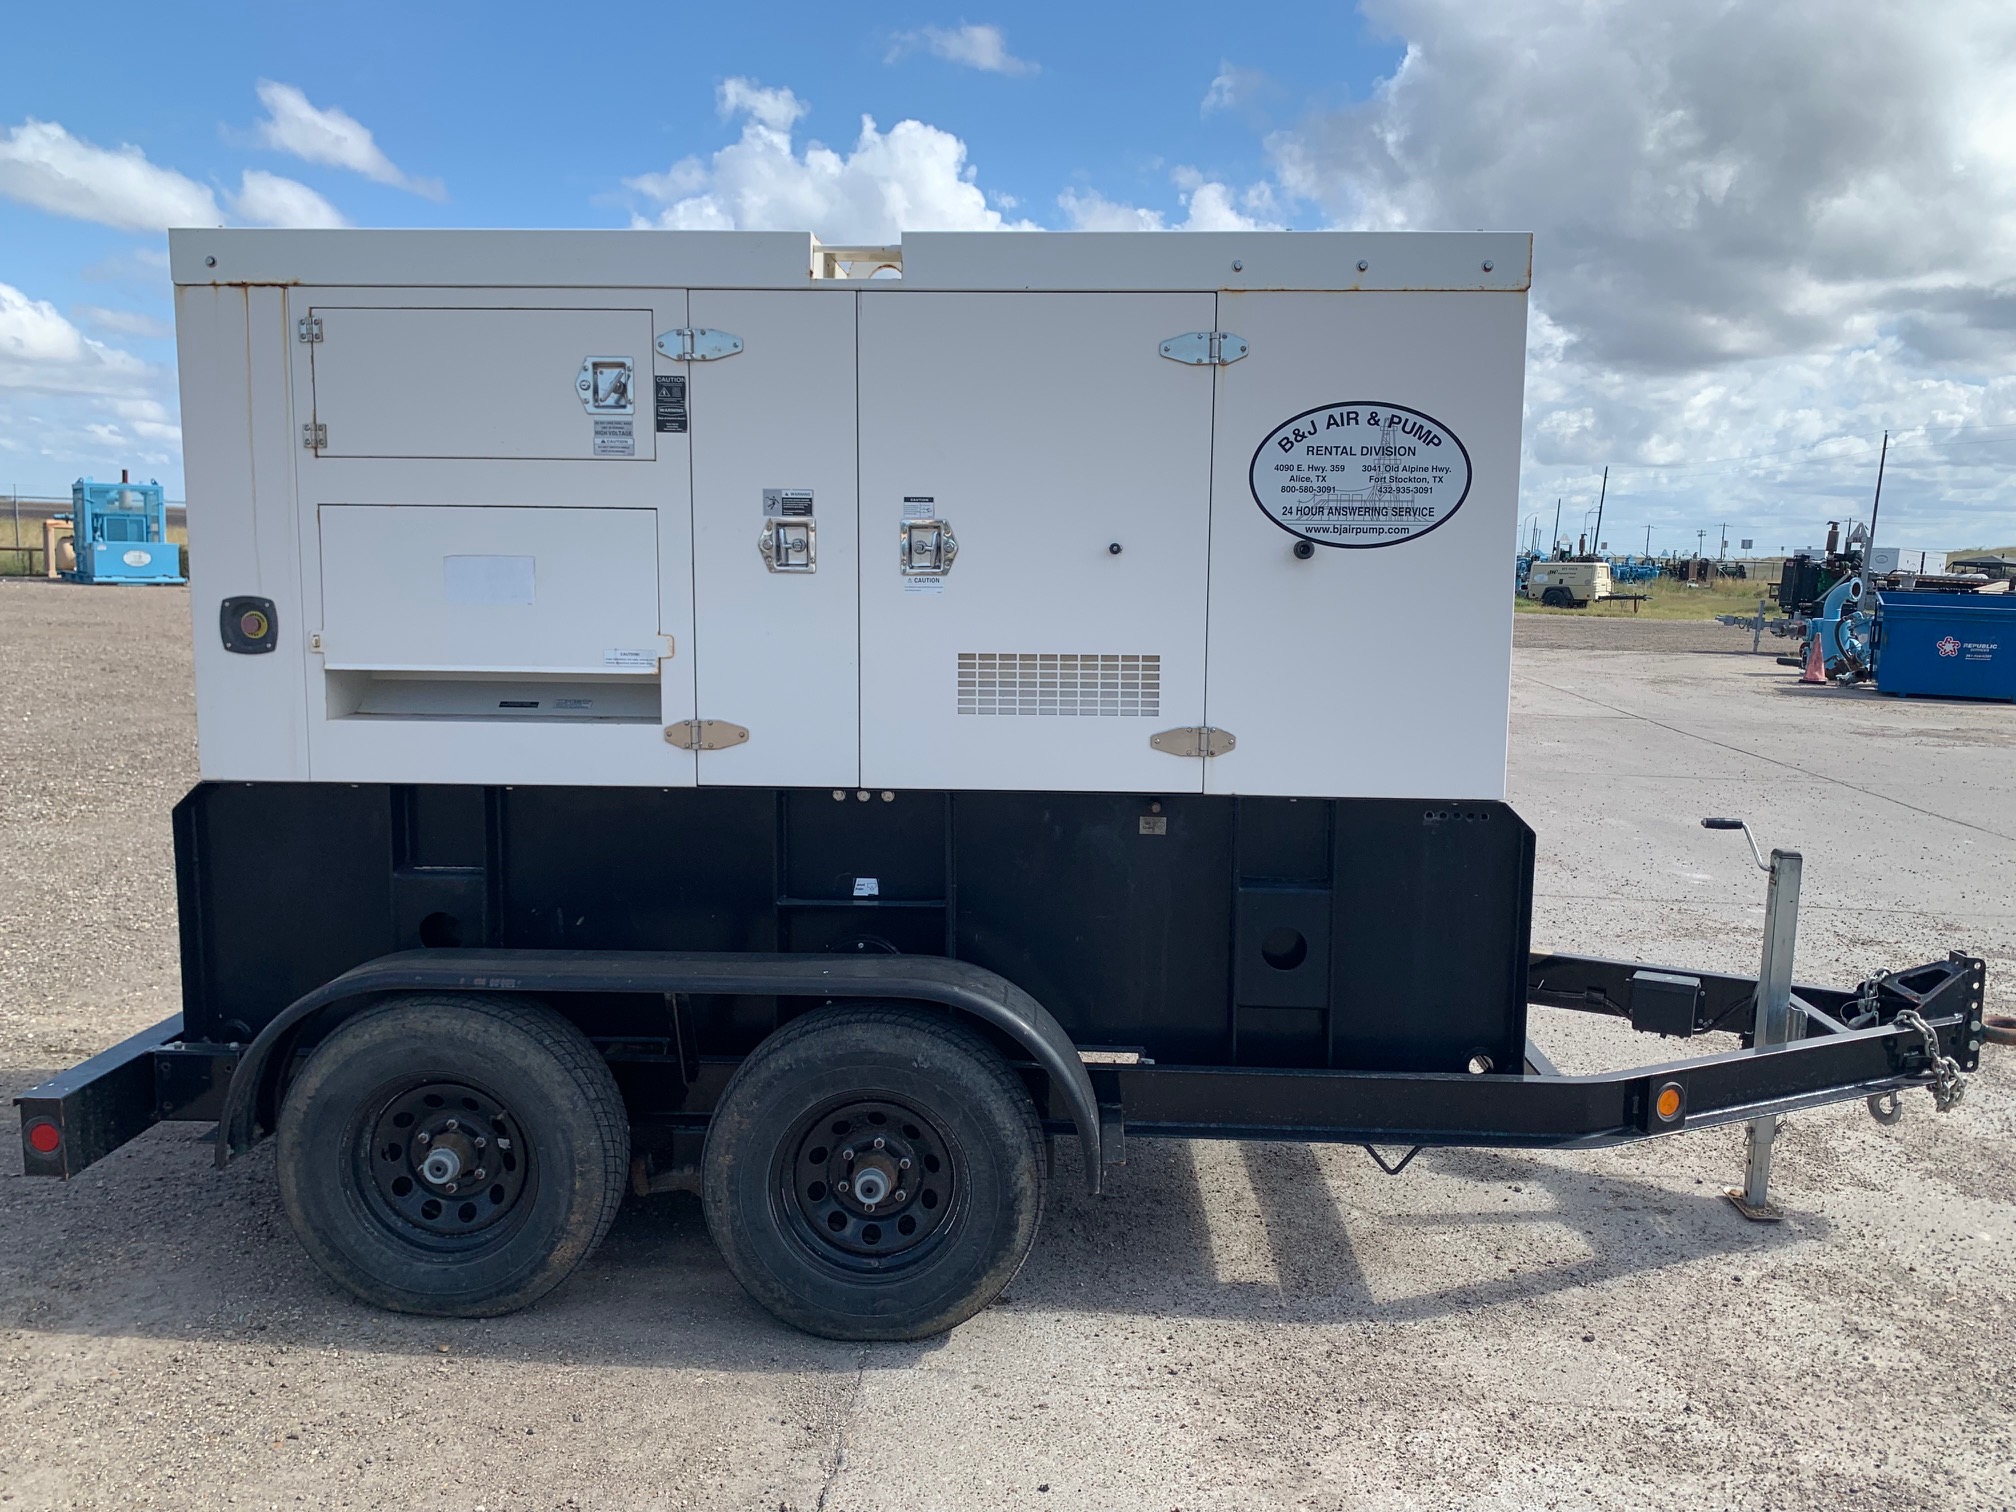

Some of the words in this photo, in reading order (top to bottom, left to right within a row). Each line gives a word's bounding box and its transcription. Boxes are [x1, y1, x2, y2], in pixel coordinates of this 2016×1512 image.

[1277, 419, 1318, 454] B&J
[1325, 410, 1360, 430] AIR
[1366, 411, 1381, 427] &
[1387, 413, 1443, 448] PUMP
[1306, 445, 1357, 456] RENTAL
[1360, 445, 1417, 457] DIVISION
[1273, 463, 1295, 472] 4090
[1296, 464, 1305, 472] E.
[1307, 464, 1328, 474] Hwy.
[1329, 464, 1346, 472] 359
[1361, 464, 1381, 473] 3041
[1384, 464, 1400, 473] Old
[1401, 464, 1430, 475] Alpine
[1431, 465, 1452, 475] Hwy.
[1288, 474, 1313, 484] Alice,
[1315, 474, 1327, 483] TX
[1368, 475, 1387, 484] Fort
[1388, 475, 1430, 485] Stockton,
[1432, 476, 1444, 484] TX
[1280, 485, 1337, 494] 800-580-3091
[1377, 486, 1433, 495] 432-935-3091
[1281, 506, 1293, 516] 24
[1295, 506, 1325, 517] HOUR
[1326, 506, 1389, 518] ANSWERING
[1390, 507, 1435, 518] SERVICE
[1305, 524, 1410, 537] www.bjairpump.com
